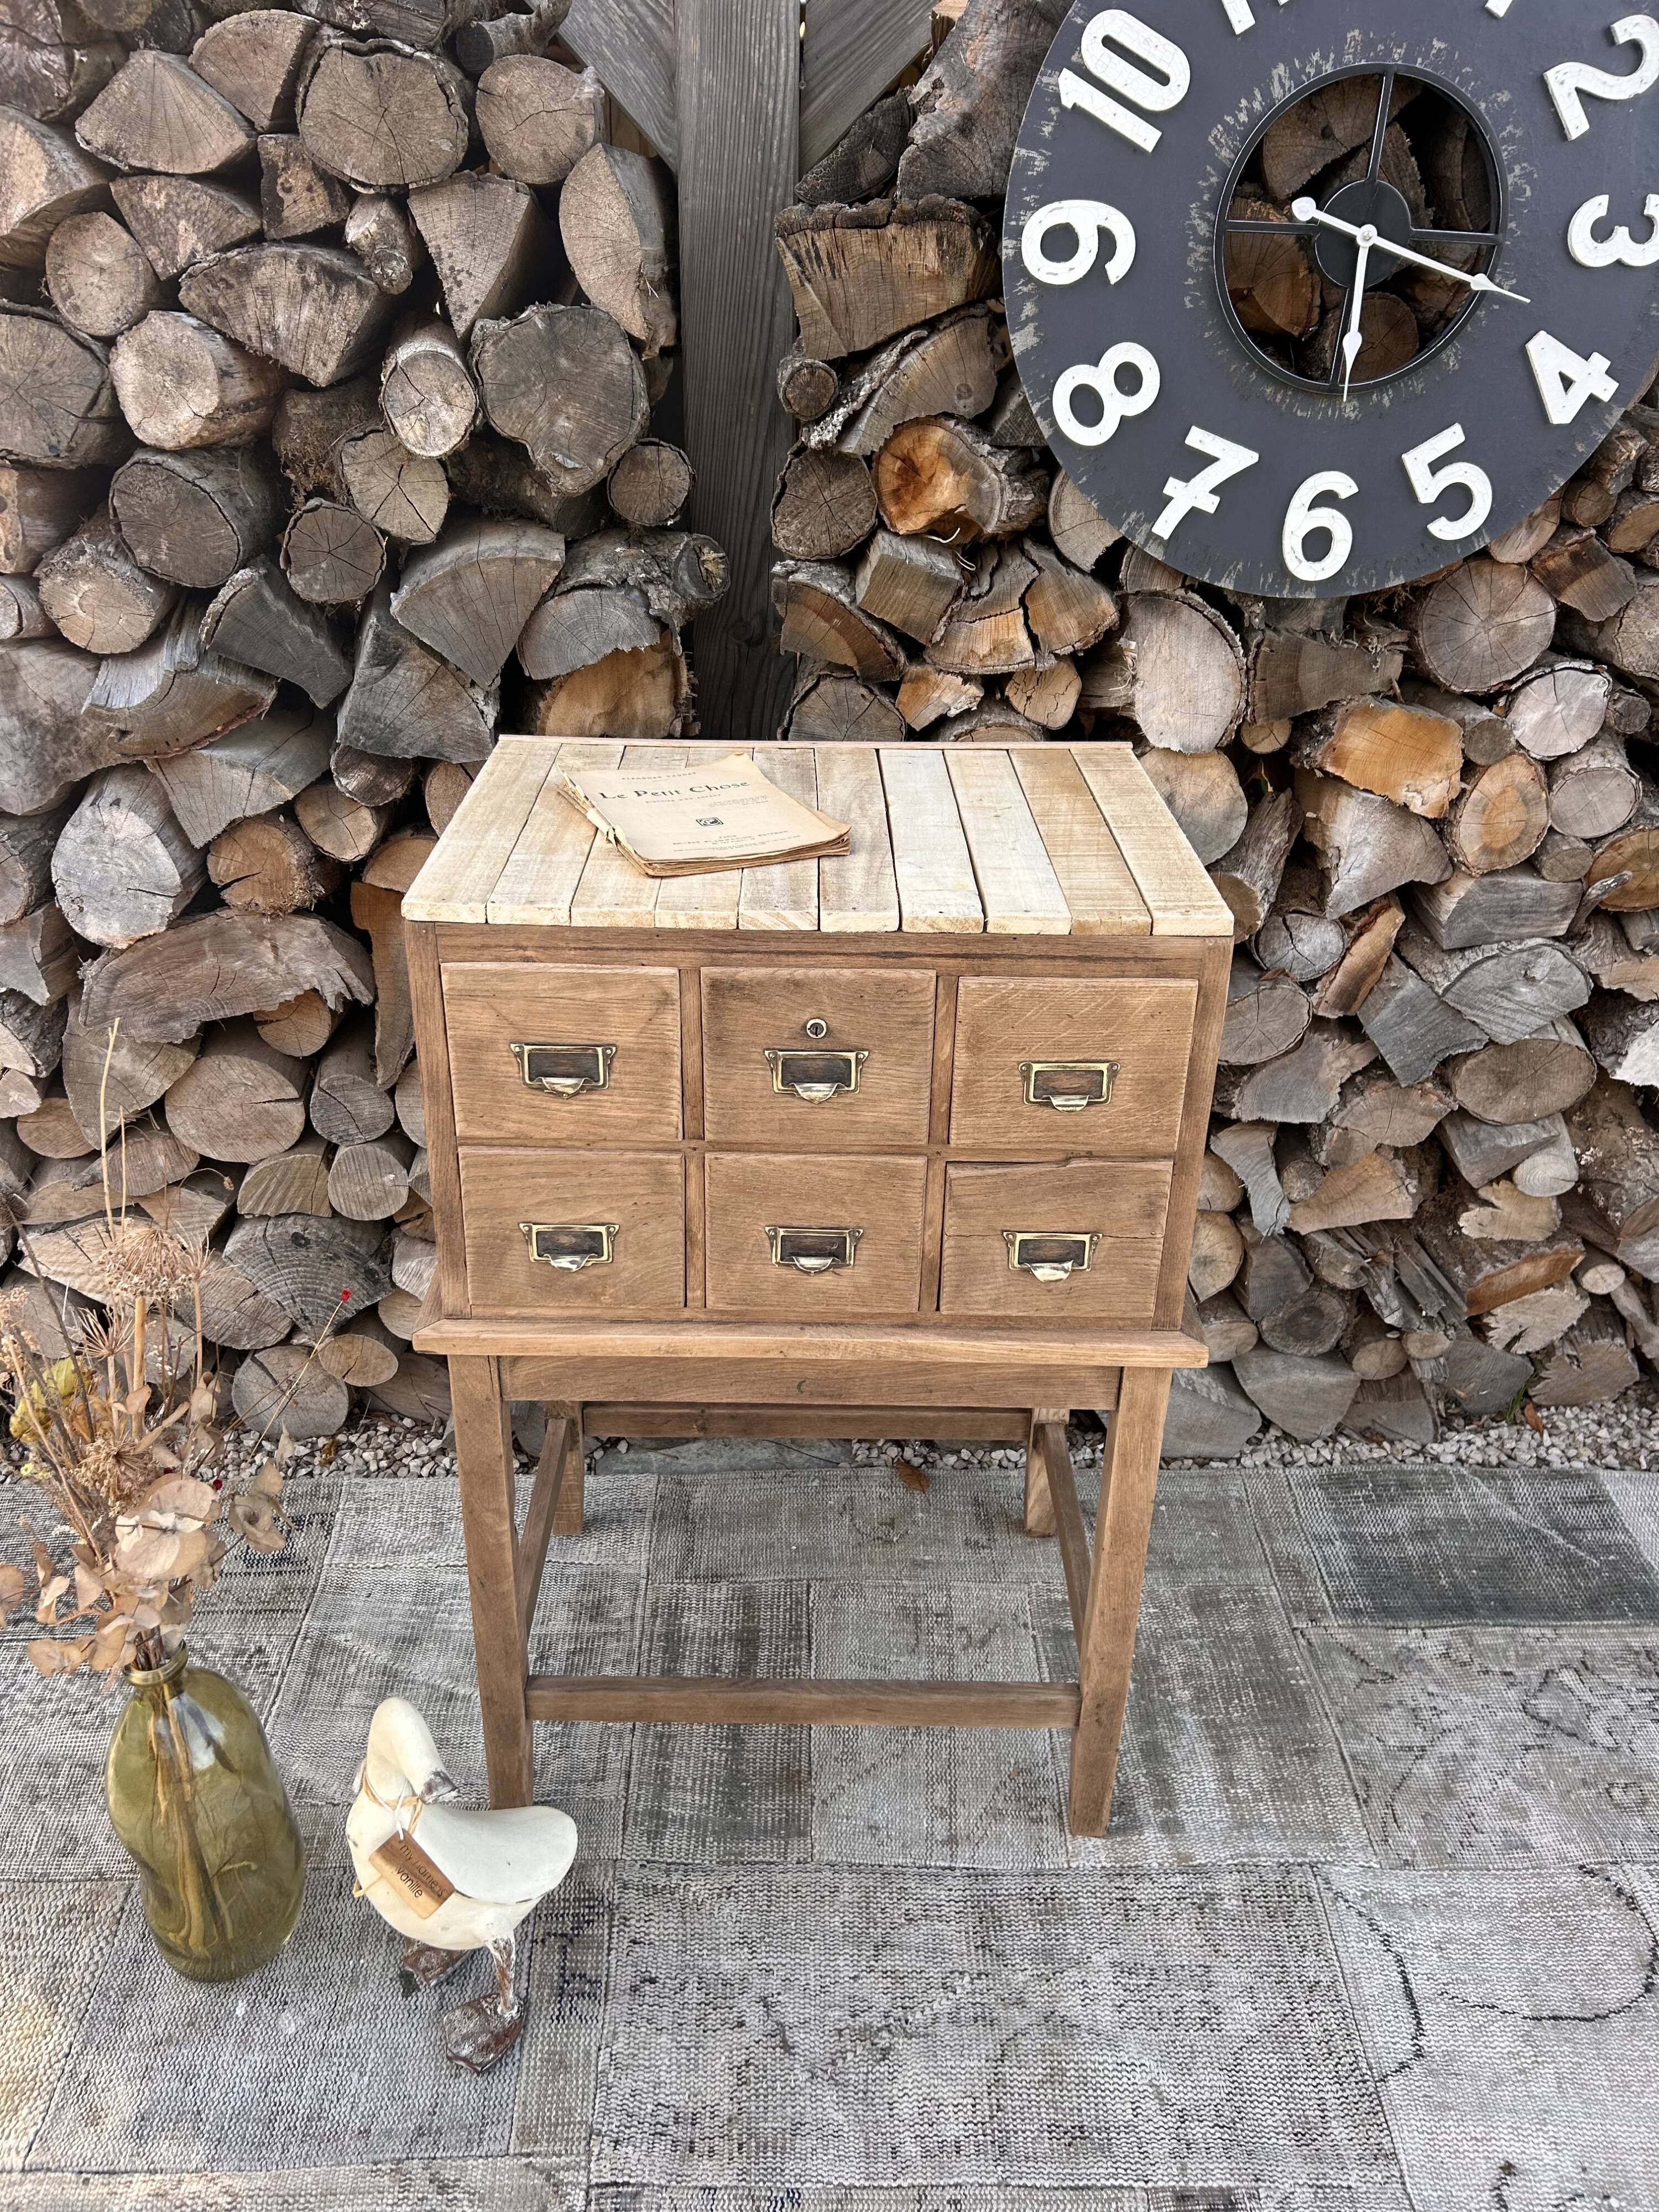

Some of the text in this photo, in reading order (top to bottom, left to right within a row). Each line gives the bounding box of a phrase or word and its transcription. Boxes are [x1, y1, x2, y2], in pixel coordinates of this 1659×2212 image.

[1057, 9, 1191, 153] 10
[1543, 14, 1659, 141] 2
[1021, 199, 1136, 285] 9
[1567, 194, 1659, 268] 3
[1052, 342, 1161, 446] 8
[1525, 330, 1619, 425] 4
[1151, 425, 1260, 540] 7
[1282, 471, 1359, 582] 6
[1401, 422, 1493, 540] 5
[689, 782, 750, 792] Chose
[397, 1867, 422, 1898] vanille
[400, 1845, 414, 1861] my
[413, 1860, 439, 1888] name
